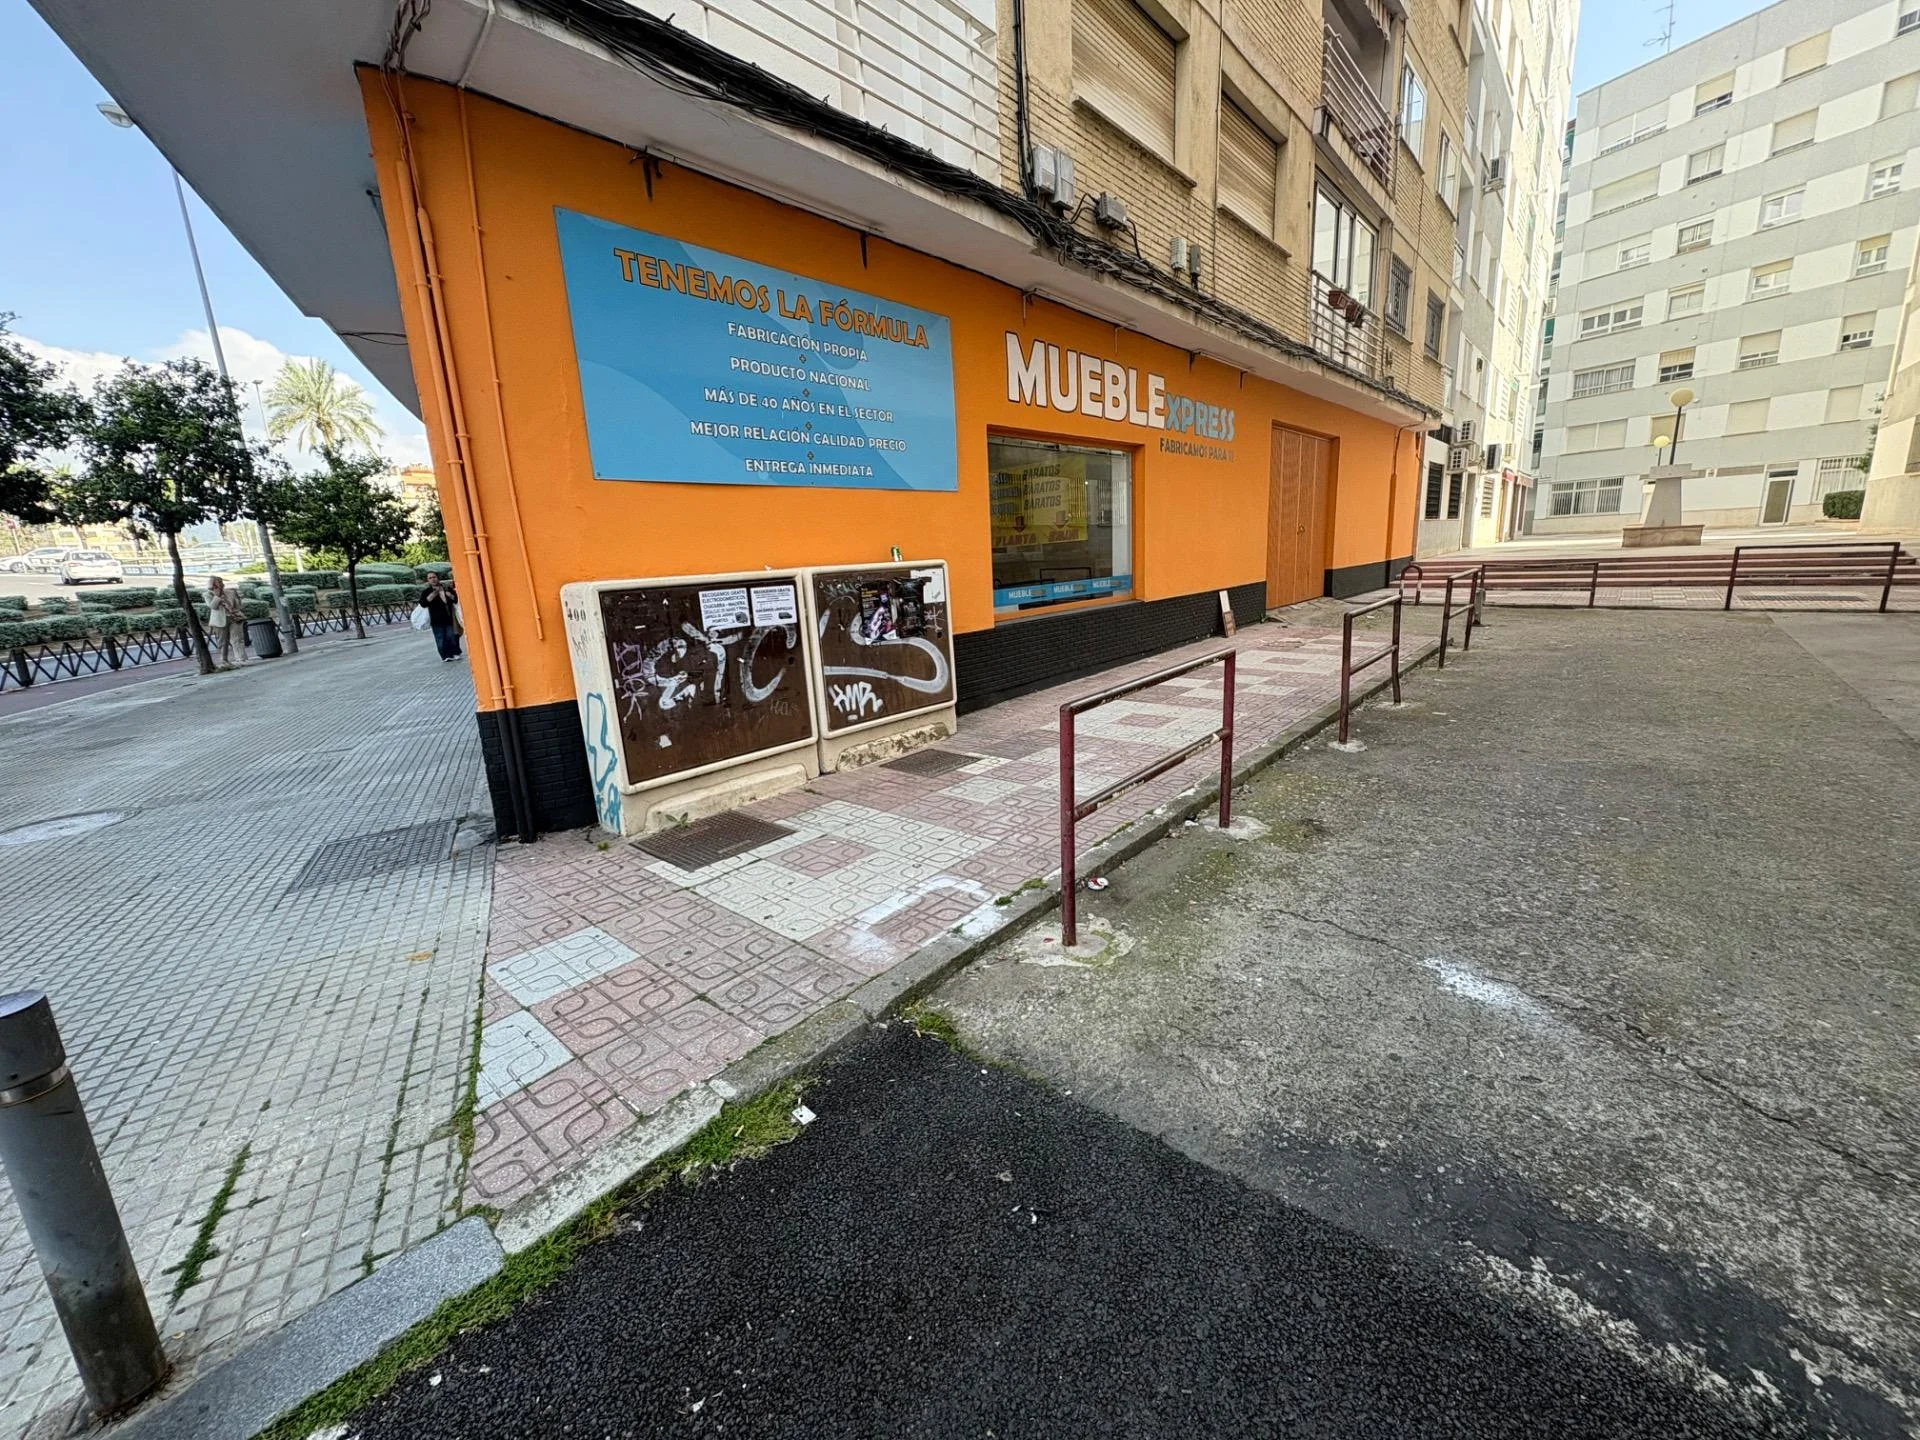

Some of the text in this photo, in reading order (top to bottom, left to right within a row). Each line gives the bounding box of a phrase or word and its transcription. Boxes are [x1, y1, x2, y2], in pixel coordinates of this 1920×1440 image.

[613, 247, 929, 349] TENEMOS LA FÓRMULA
[727, 322, 868, 361] FABRICACIÓN PROPIA
[729, 356, 872, 391] PRODUCTO NACIONAL
[704, 386, 894, 423] MÁS DE 40 AÑOS EN EL SECTOR
[690, 420, 907, 452] MEJOR RELACIÓN CALIDAD PRECIO
[745, 458, 874, 477] ENTREGA INMEDIATA
